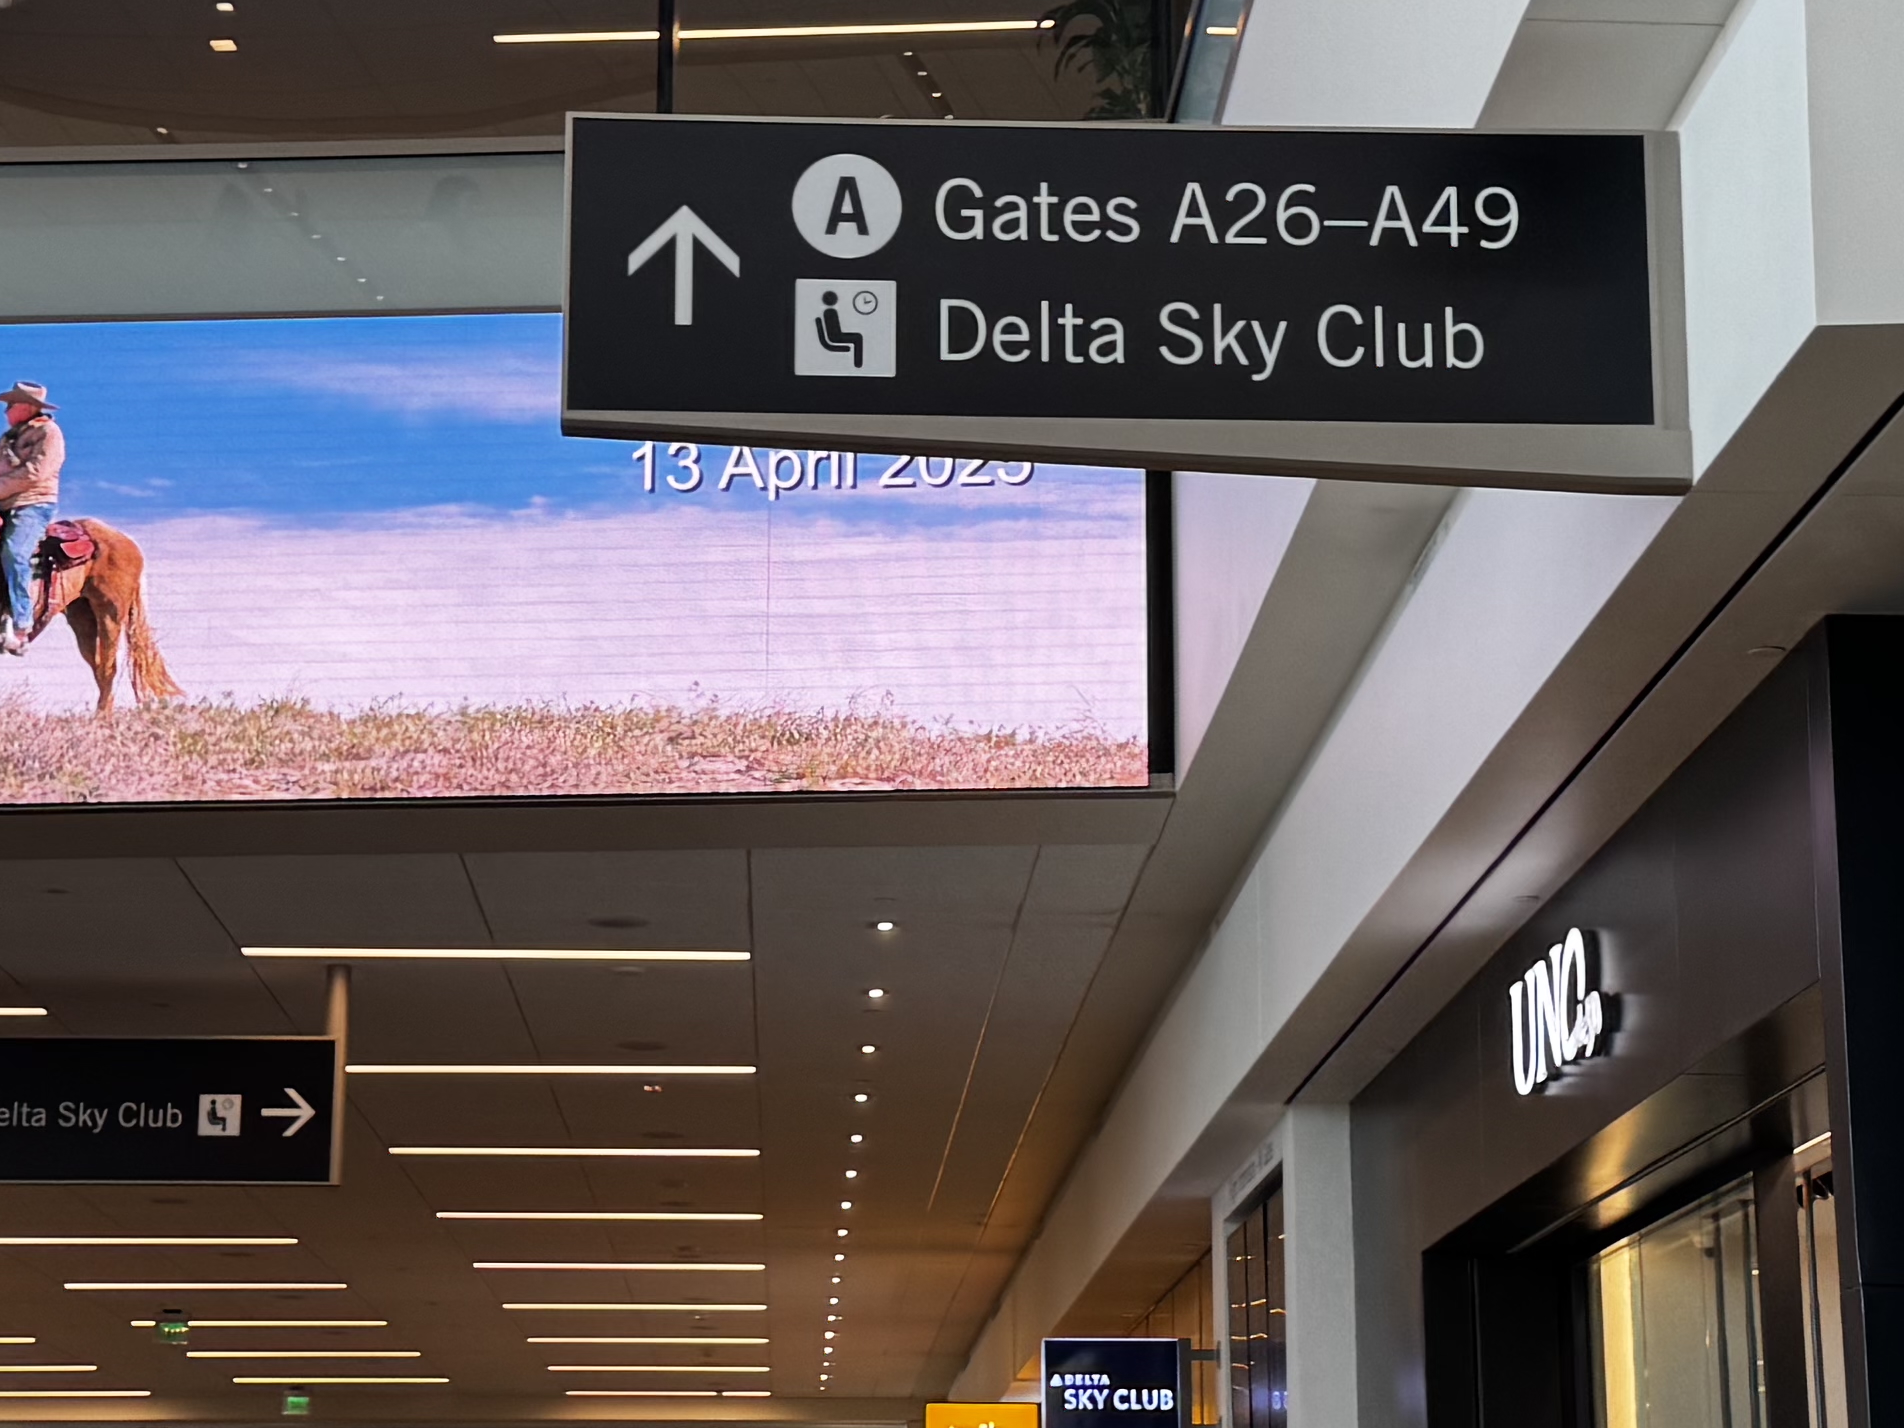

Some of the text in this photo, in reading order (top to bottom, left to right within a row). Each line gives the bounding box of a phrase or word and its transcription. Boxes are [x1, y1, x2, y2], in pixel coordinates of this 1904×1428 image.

[825, 177, 1519, 249] A Gates A26–A49
[939, 299, 1484, 381] Delta Sky Club
[632, 440, 702, 490] 13
[718, 445, 858, 500] April
[58, 1101, 108, 1133] Sky
[118, 1101, 183, 1128] Club
[1063, 1374, 1110, 1386] DELTA
[1064, 1388, 1175, 1412] SKY CLUB
